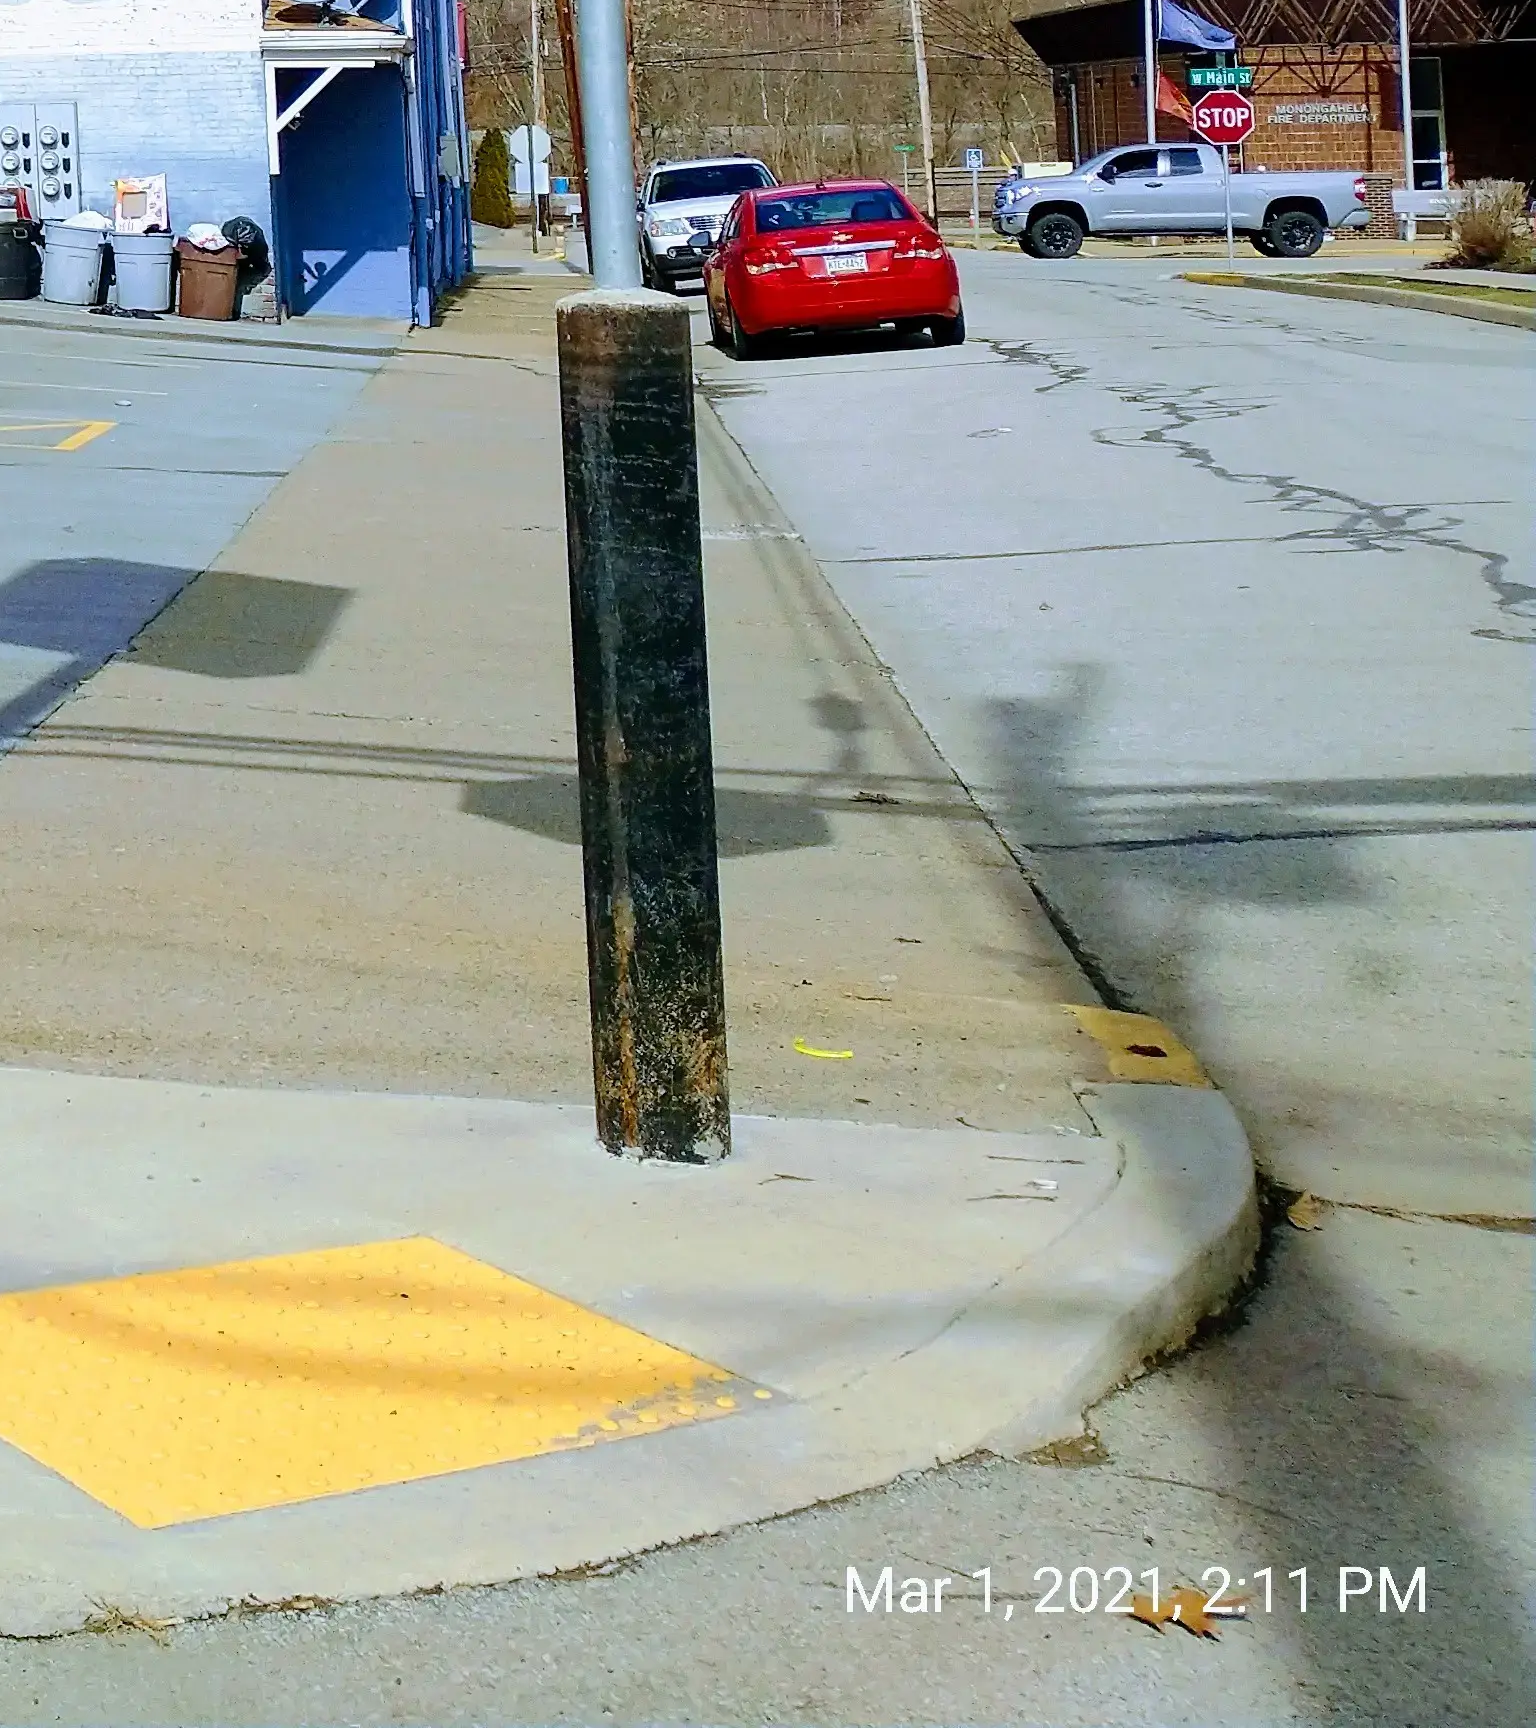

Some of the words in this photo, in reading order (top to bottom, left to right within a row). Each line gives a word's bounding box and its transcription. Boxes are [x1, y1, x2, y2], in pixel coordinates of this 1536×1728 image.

[1206, 70, 1235, 84] Main
[1239, 70, 1251, 84] St
[1275, 103, 1370, 115] MONONGAHELA
[1198, 107, 1250, 129] STOP
[1268, 114, 1294, 124] FIRE
[1300, 113, 1378, 124] DEPARTMENT
